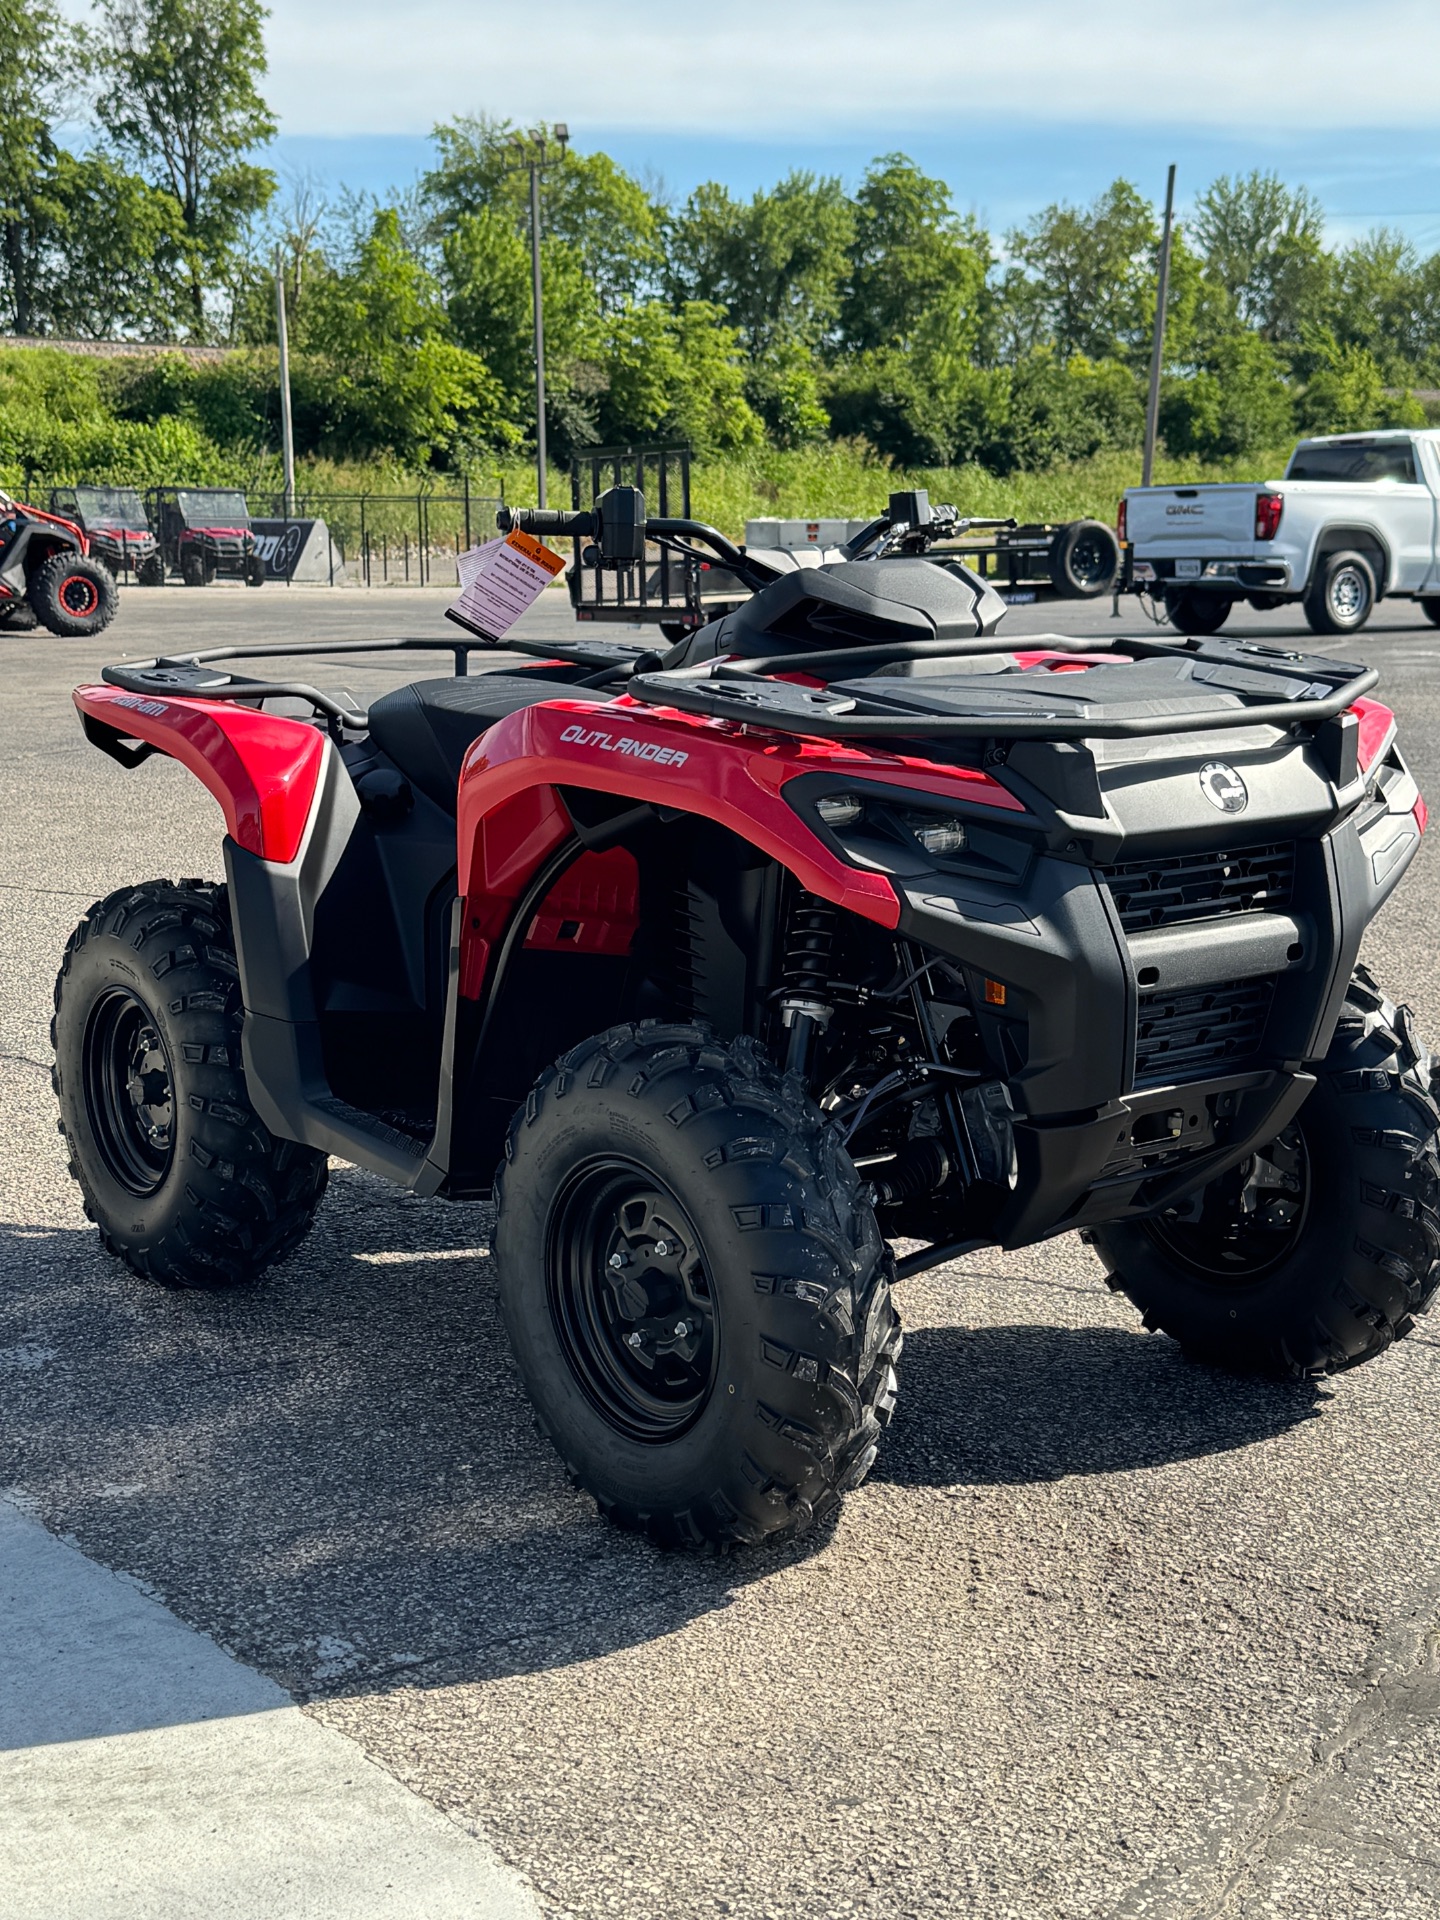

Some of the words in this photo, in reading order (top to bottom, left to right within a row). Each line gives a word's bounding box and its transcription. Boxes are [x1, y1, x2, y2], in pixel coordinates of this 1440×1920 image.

[1166, 504, 1205, 516] GMC
[109, 696, 170, 717] can-am
[560, 724, 689, 768] OUTLANDER
